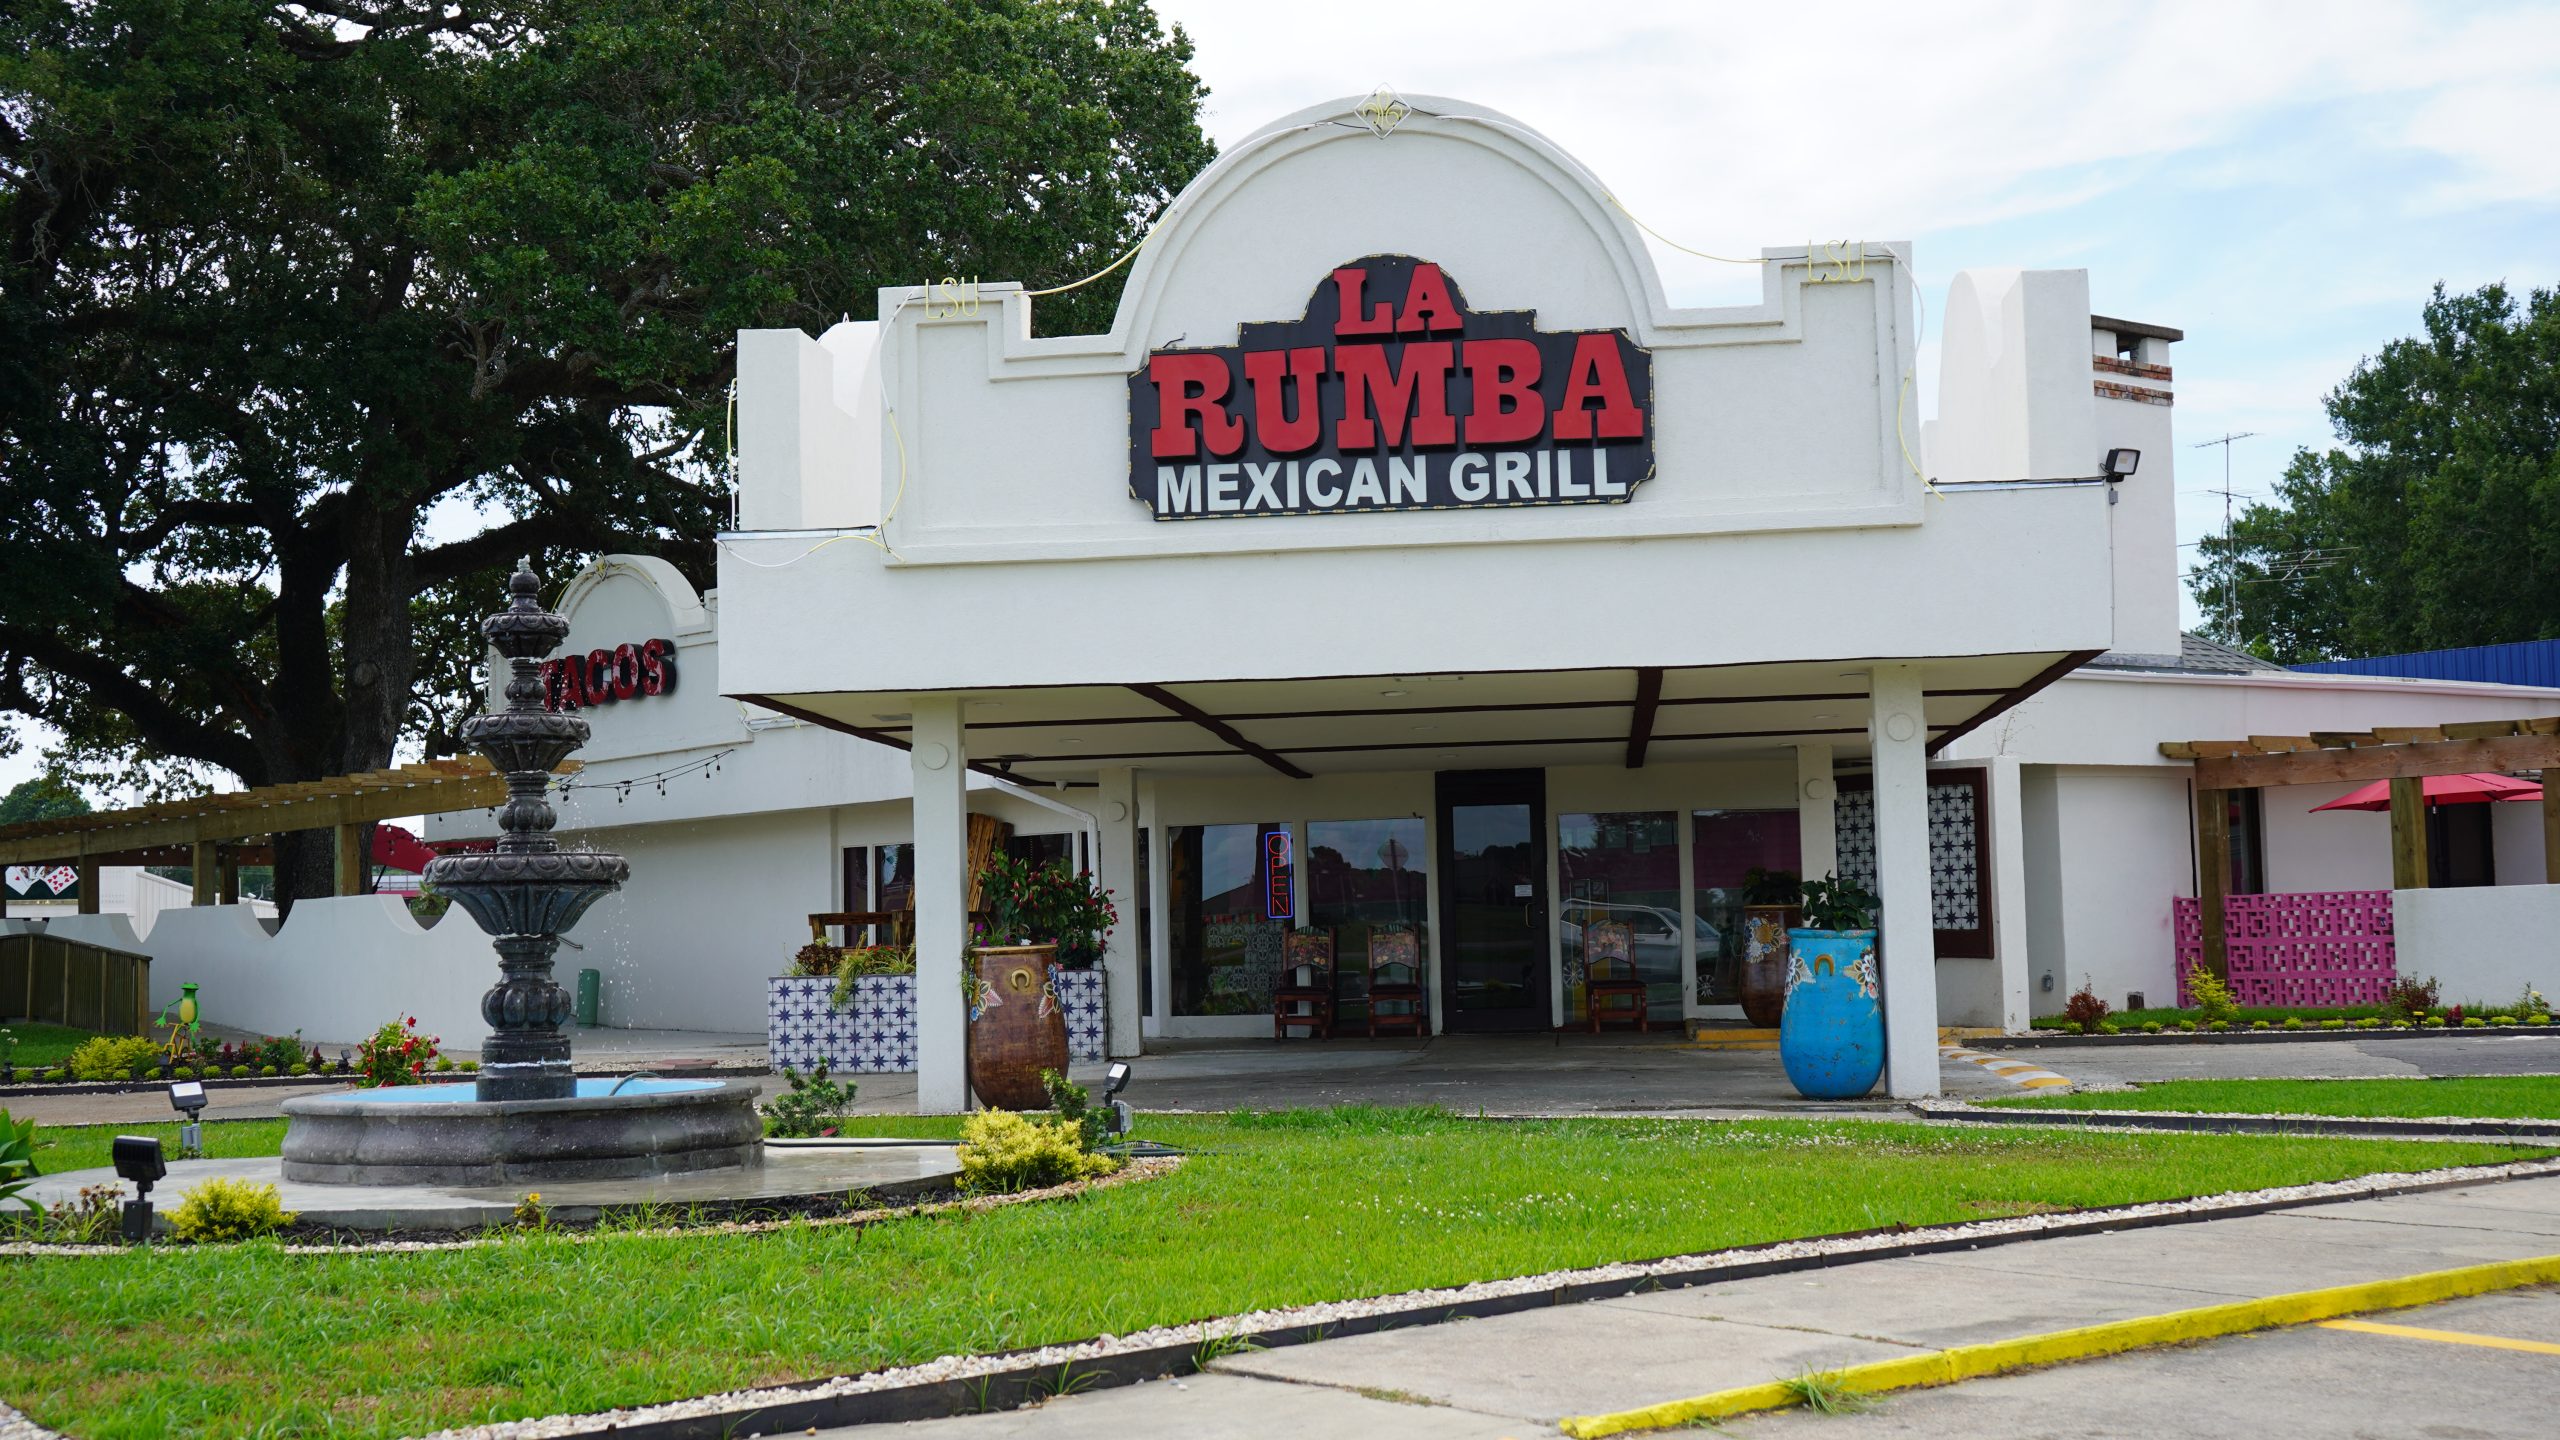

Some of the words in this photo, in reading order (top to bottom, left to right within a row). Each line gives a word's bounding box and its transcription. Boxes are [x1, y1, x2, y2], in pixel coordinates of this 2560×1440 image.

[925, 275, 979, 319] LSU
[1808, 239, 1864, 282] LSU
[1333, 263, 1463, 336] LA
[1149, 333, 1644, 458] RUMBA
[1157, 455, 1428, 514] MEXICAN
[1449, 447, 1627, 502] GRILL
[540, 638, 676, 713] TACOS
[1268, 835, 1289, 916] OPEN
